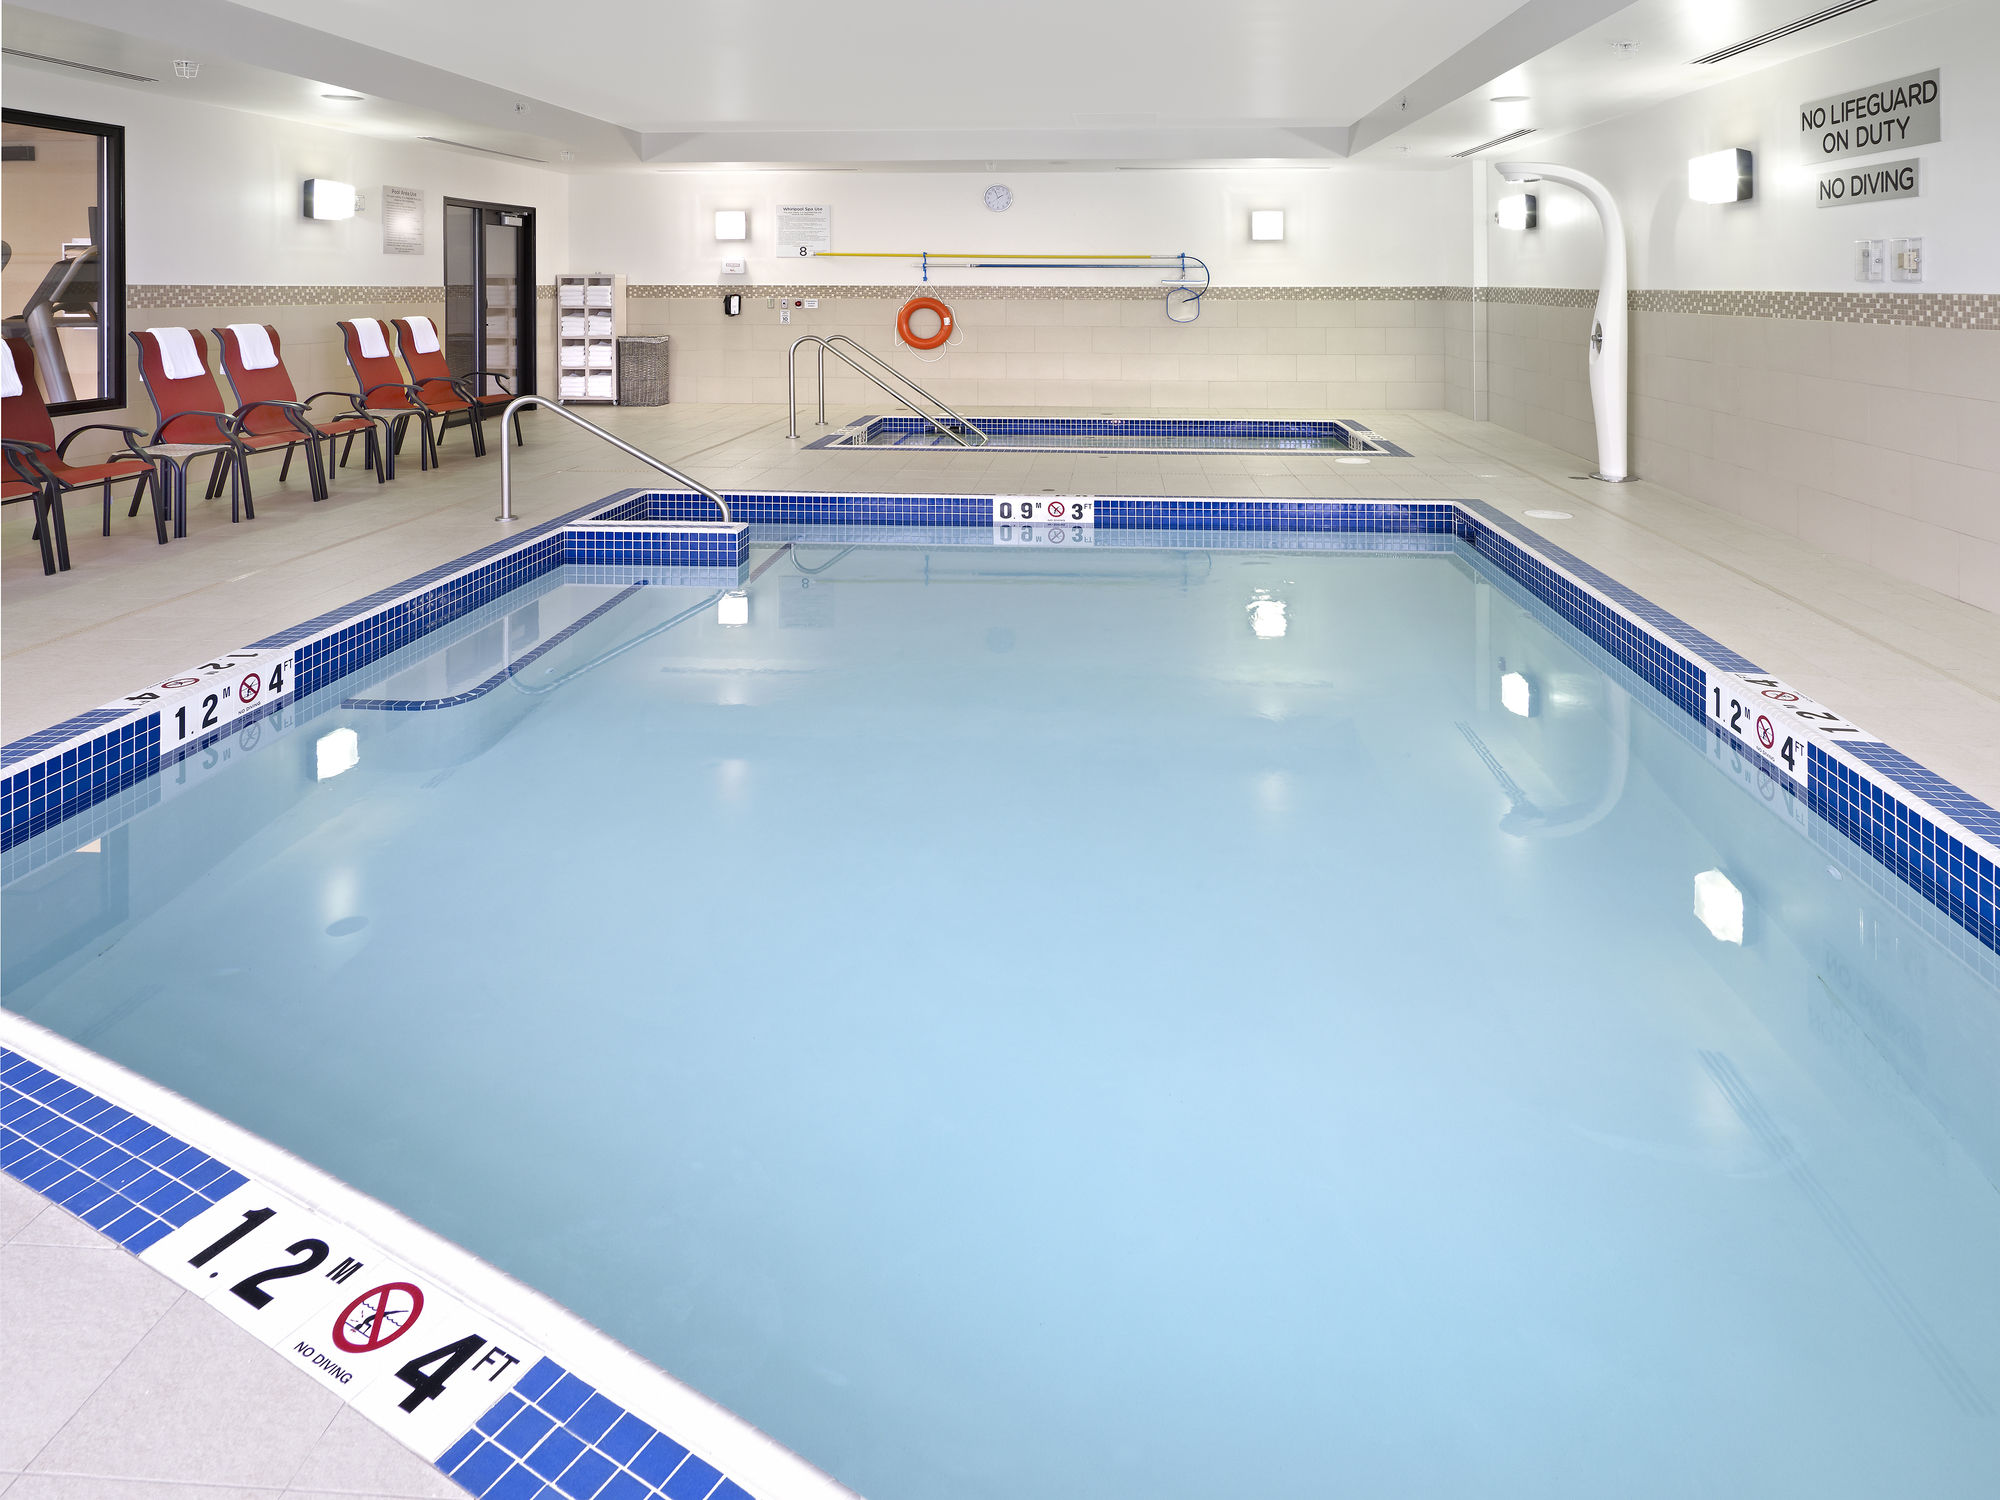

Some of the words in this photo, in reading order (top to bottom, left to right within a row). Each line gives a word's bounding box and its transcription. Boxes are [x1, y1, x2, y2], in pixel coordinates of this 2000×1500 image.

[1801, 106, 1826, 132] NO
[1831, 79, 1938, 125] LIFEGUARD
[1822, 129, 1849, 154] ON
[1856, 116, 1911, 148] DUTY
[1819, 177, 1845, 201] NO
[1850, 167, 1914, 197] DIVING
[799, 246, 808, 257] 8
[293, 1341, 316, 1358] NO
[310, 1352, 354, 1385] DIVING
